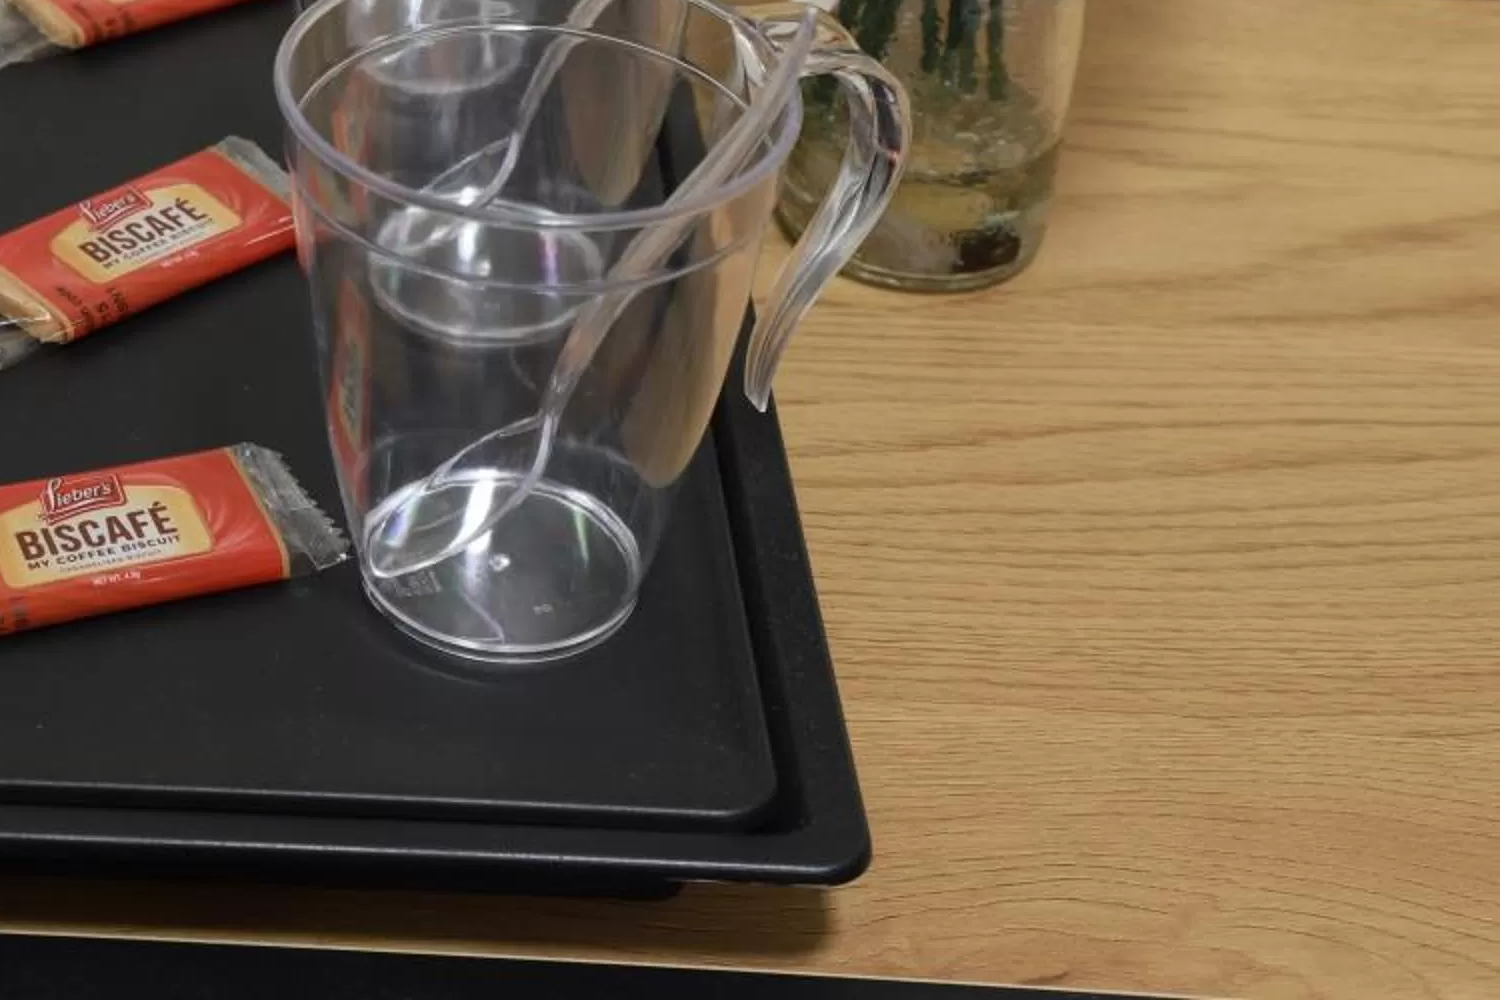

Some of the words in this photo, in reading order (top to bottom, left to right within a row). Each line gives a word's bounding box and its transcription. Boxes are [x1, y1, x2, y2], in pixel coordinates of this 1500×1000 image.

[77, 197, 208, 264] BISCAFÉ
[15, 501, 178, 561] BISCAFÉ
[27, 559, 52, 572] MY
[55, 546, 117, 565] COFFEE
[121, 535, 182, 552] BISCUIT
